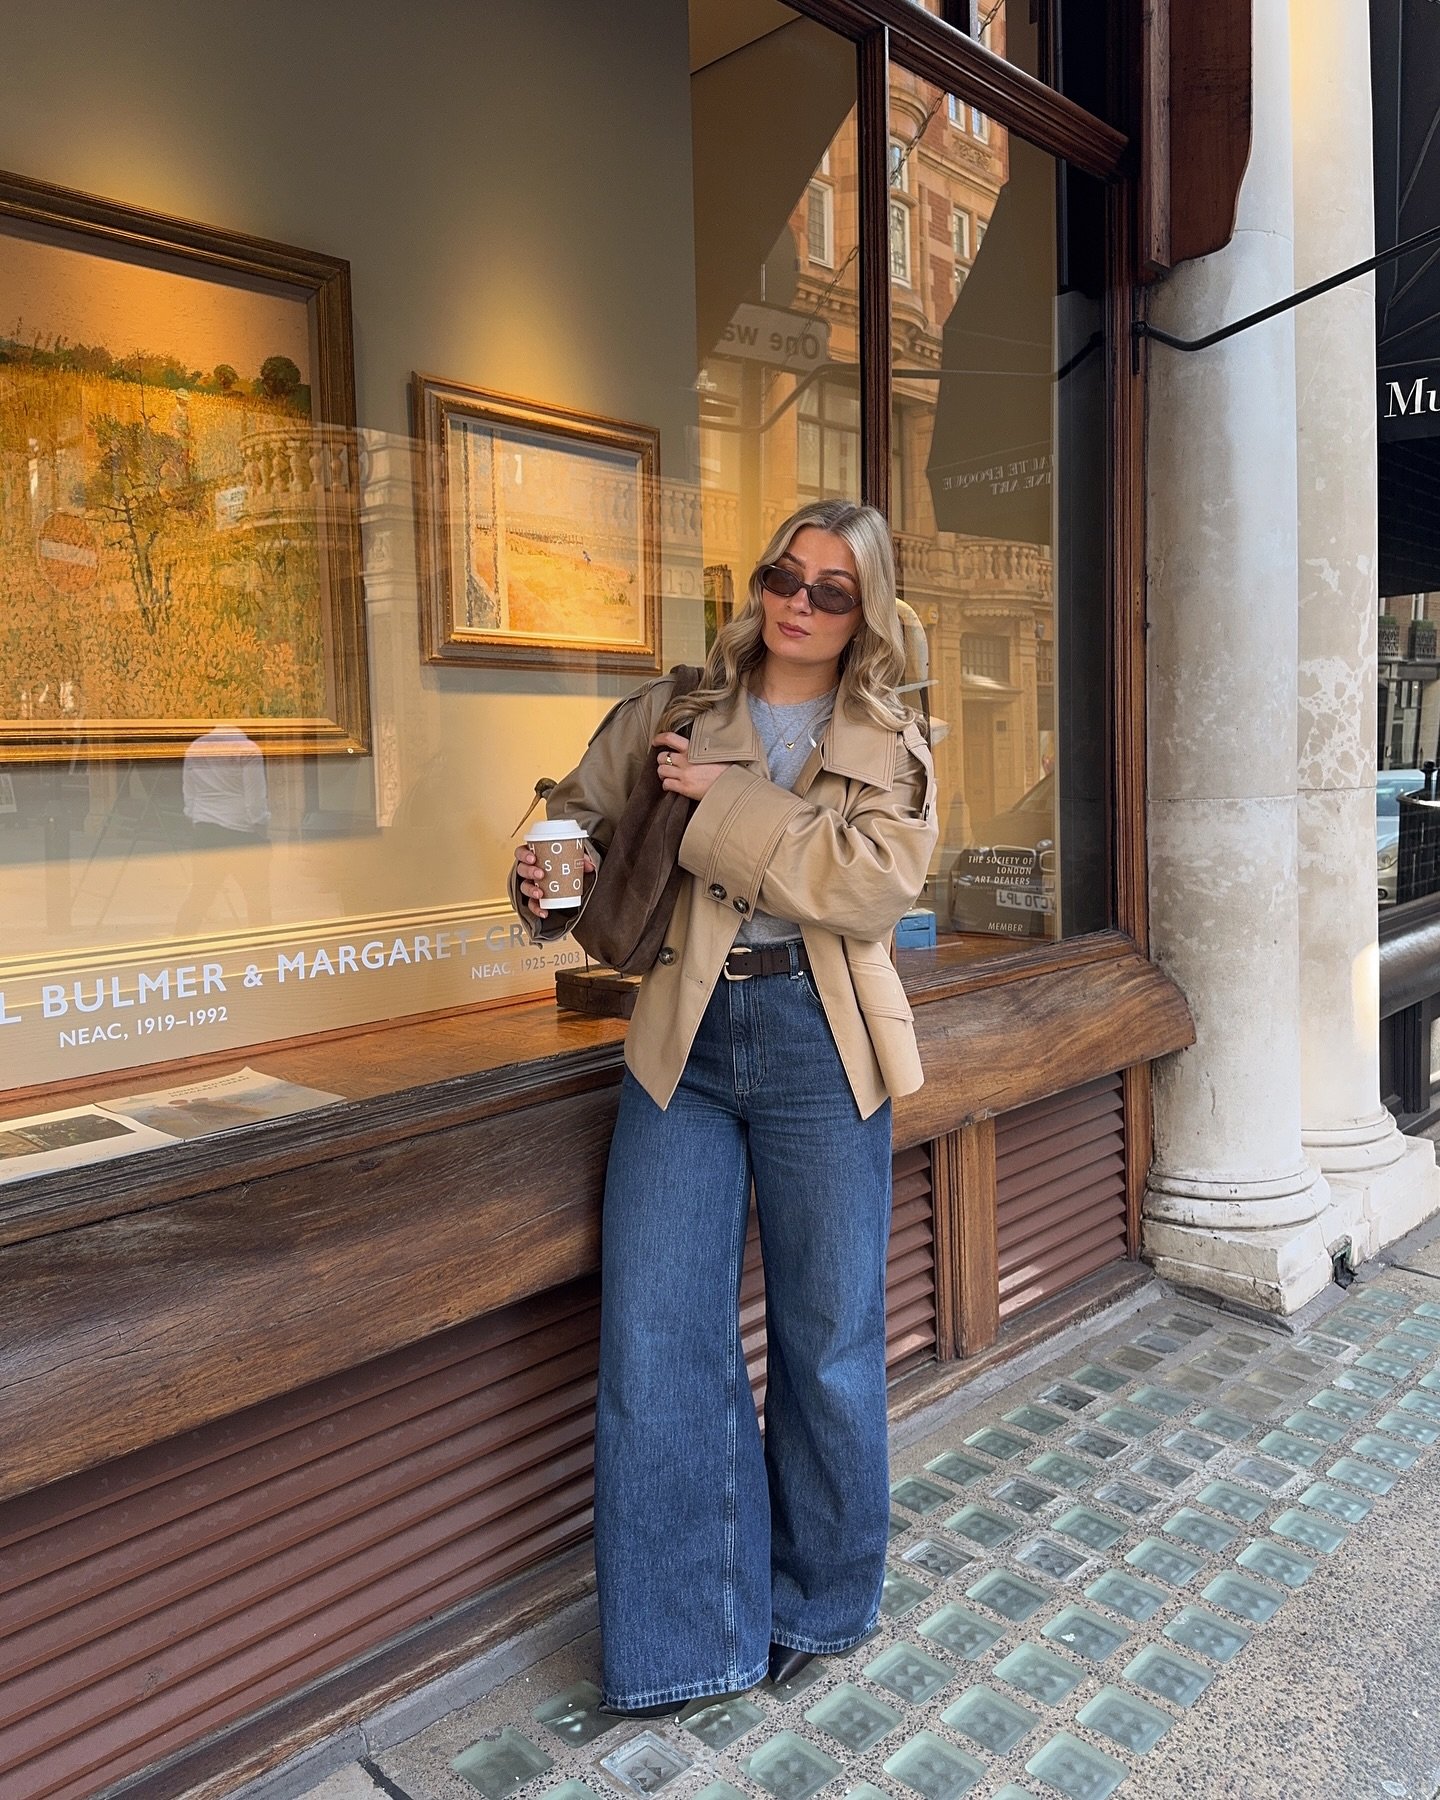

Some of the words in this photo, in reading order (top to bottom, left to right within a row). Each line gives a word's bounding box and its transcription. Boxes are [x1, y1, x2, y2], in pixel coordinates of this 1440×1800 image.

[968, 855, 984, 864] THE
[986, 856, 1020, 865] SOCIETY
[1022, 857, 1033, 865] OF
[996, 866, 1032, 875] LONDON
[974, 875, 991, 884] ART
[993, 876, 1030, 885] DEALERS
[987, 922, 1024, 932] MEMBER
[42, 962, 228, 1019] BULMER
[243, 964, 264, 988] &
[277, 928, 473, 983] MARGARET
[59, 1022, 129, 1048] NEAC,
